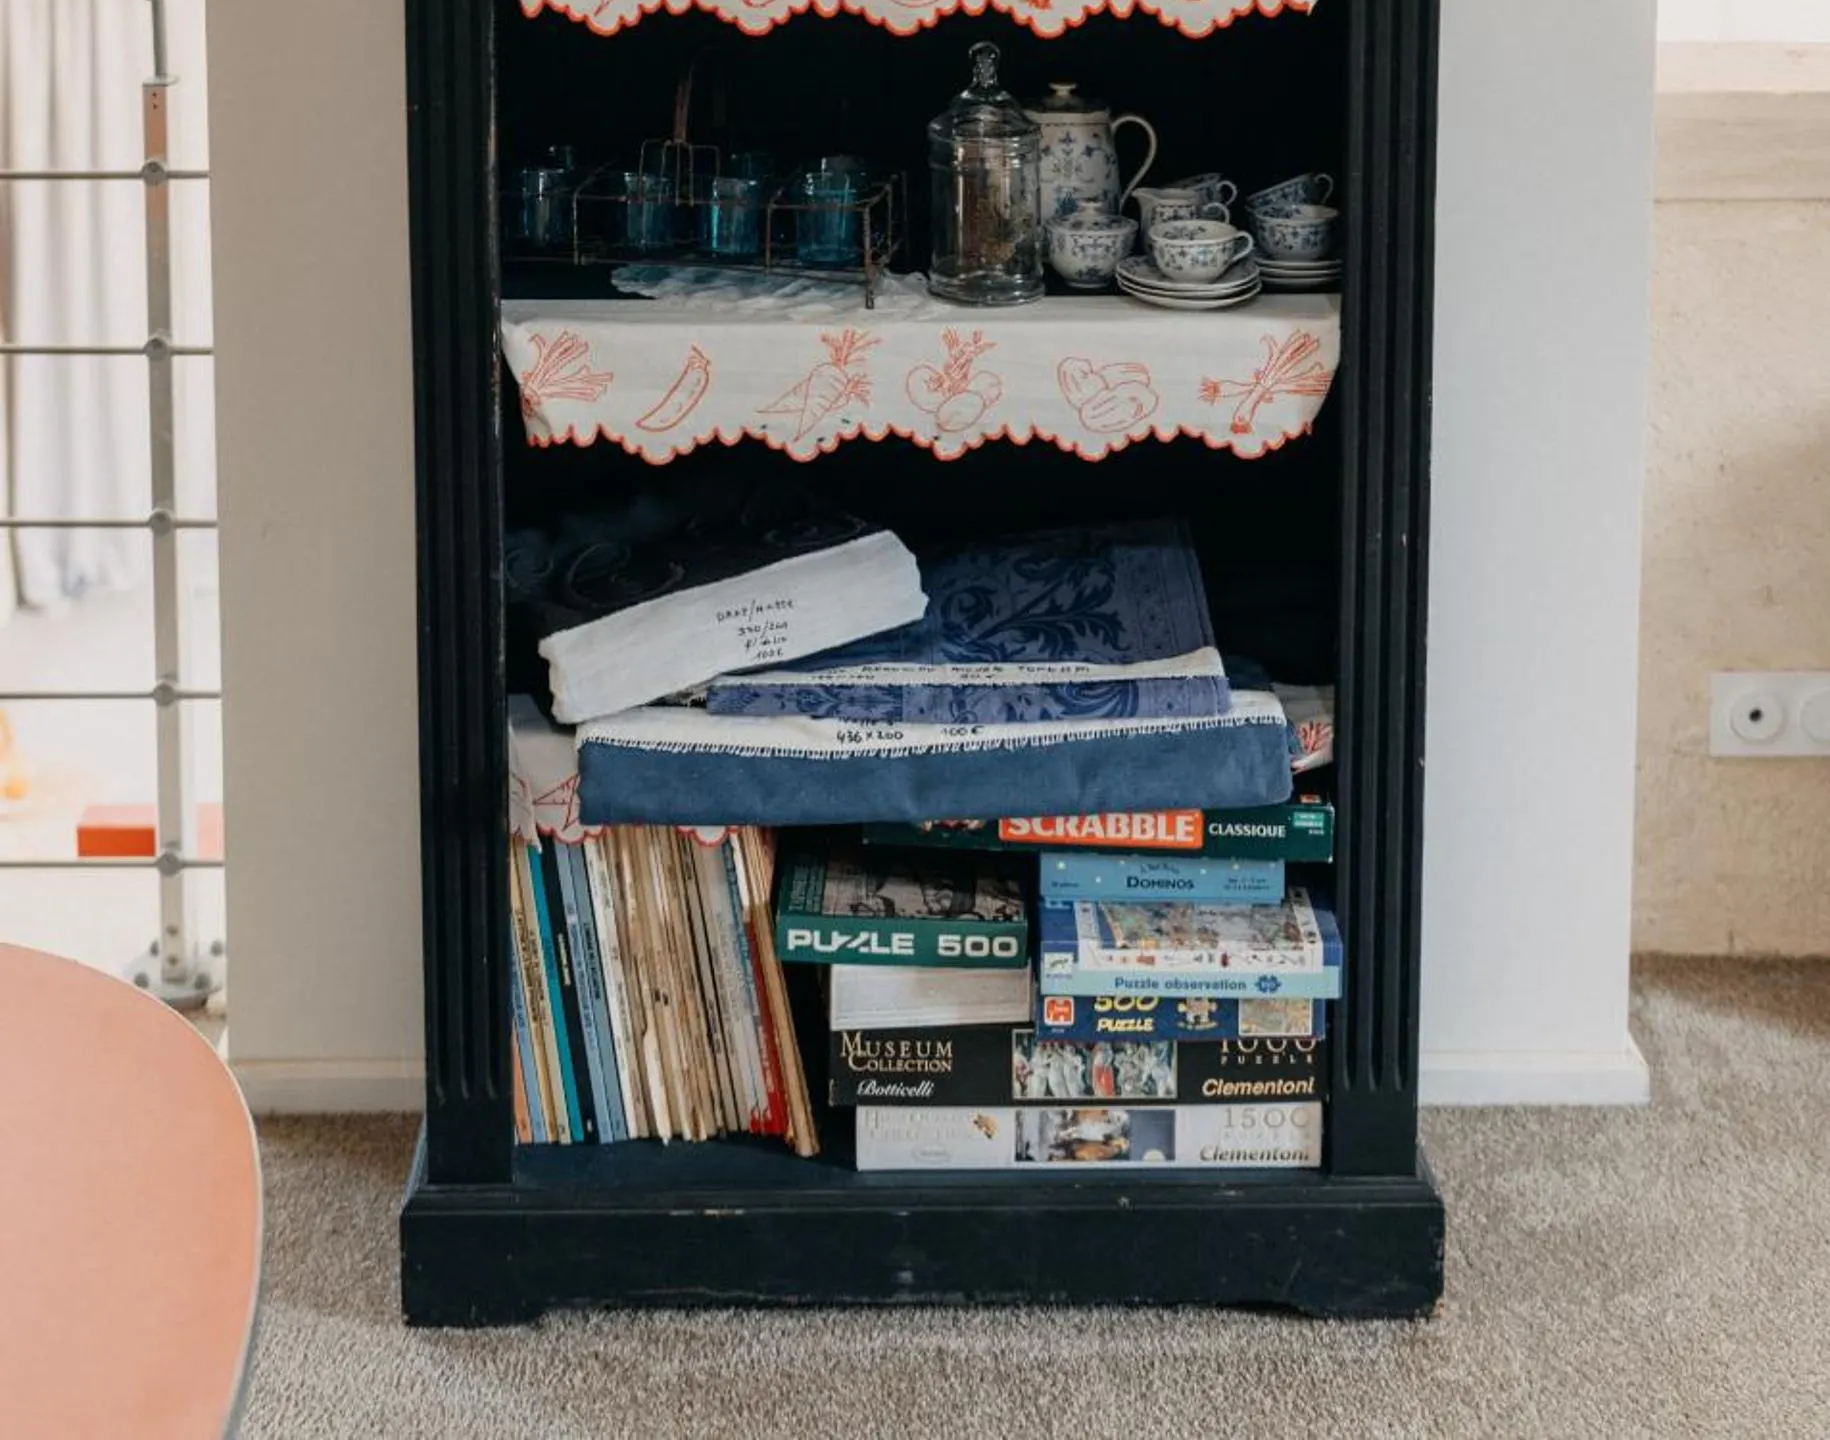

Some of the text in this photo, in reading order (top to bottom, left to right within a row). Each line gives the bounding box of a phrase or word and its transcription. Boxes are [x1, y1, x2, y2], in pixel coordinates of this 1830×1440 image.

[1008, 812, 1197, 843] SCRABBLE
[1208, 822, 1287, 839] CLASSIQUE
[787, 928, 1019, 958] PUZZLE 500
[1114, 976, 1160, 991] Puzzle
[1164, 977, 1247, 992] observation
[1096, 1017, 1154, 1033] PUZZLE
[840, 1030, 953, 1059] MUSEUM
[848, 1051, 952, 1073] COLLECTION
[856, 1079, 935, 1098] Botticelli
[1202, 1076, 1316, 1097] Clementoni
